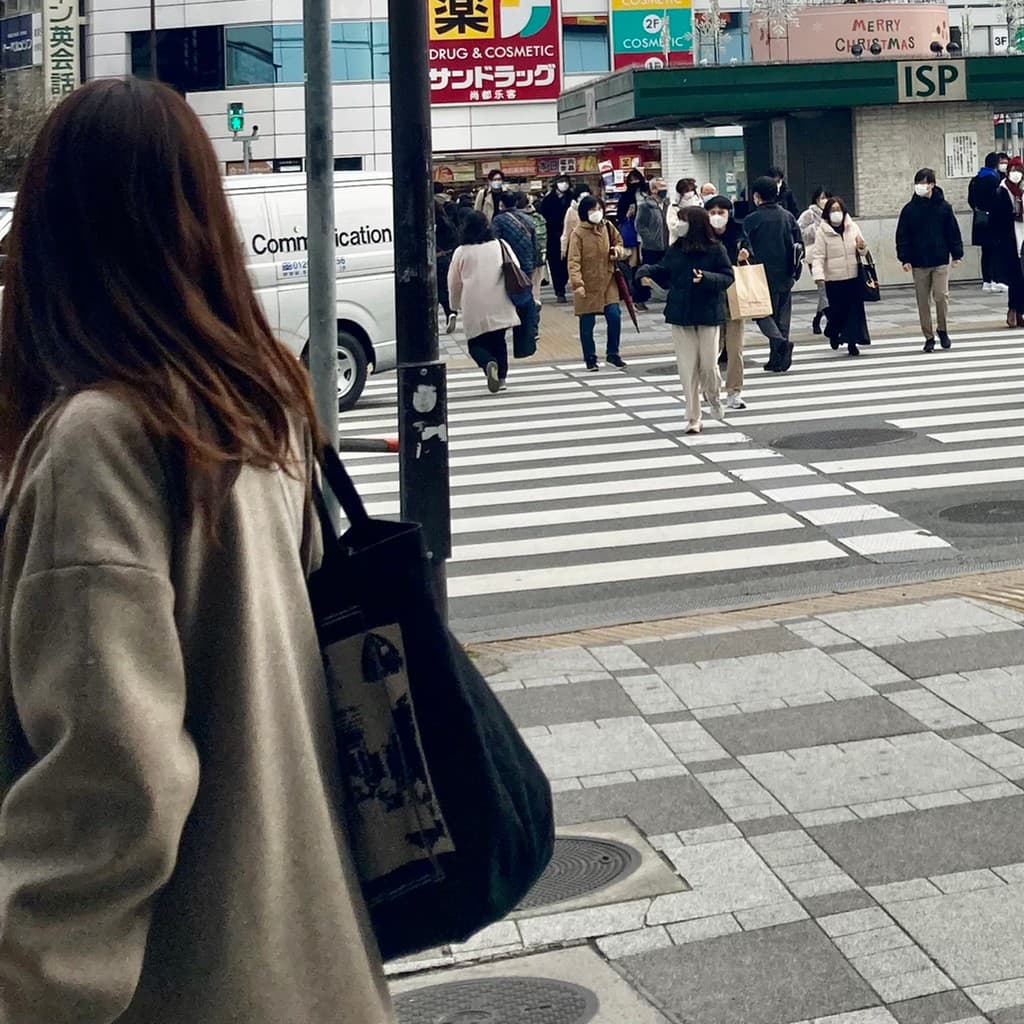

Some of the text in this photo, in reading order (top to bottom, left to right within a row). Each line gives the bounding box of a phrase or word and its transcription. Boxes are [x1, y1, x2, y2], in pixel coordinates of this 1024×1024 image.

[645, 18, 660, 29] 2F
[852, 18, 901, 32] MERRY
[835, 36, 915, 52] CHRISTMAS
[994, 37, 1007, 47] 3F
[429, 45, 554, 60] DRUG & COSMETIC
[429, 64, 556, 90] サンドラッグ
[904, 65, 959, 97] ISP
[252, 225, 393, 255] Commication
